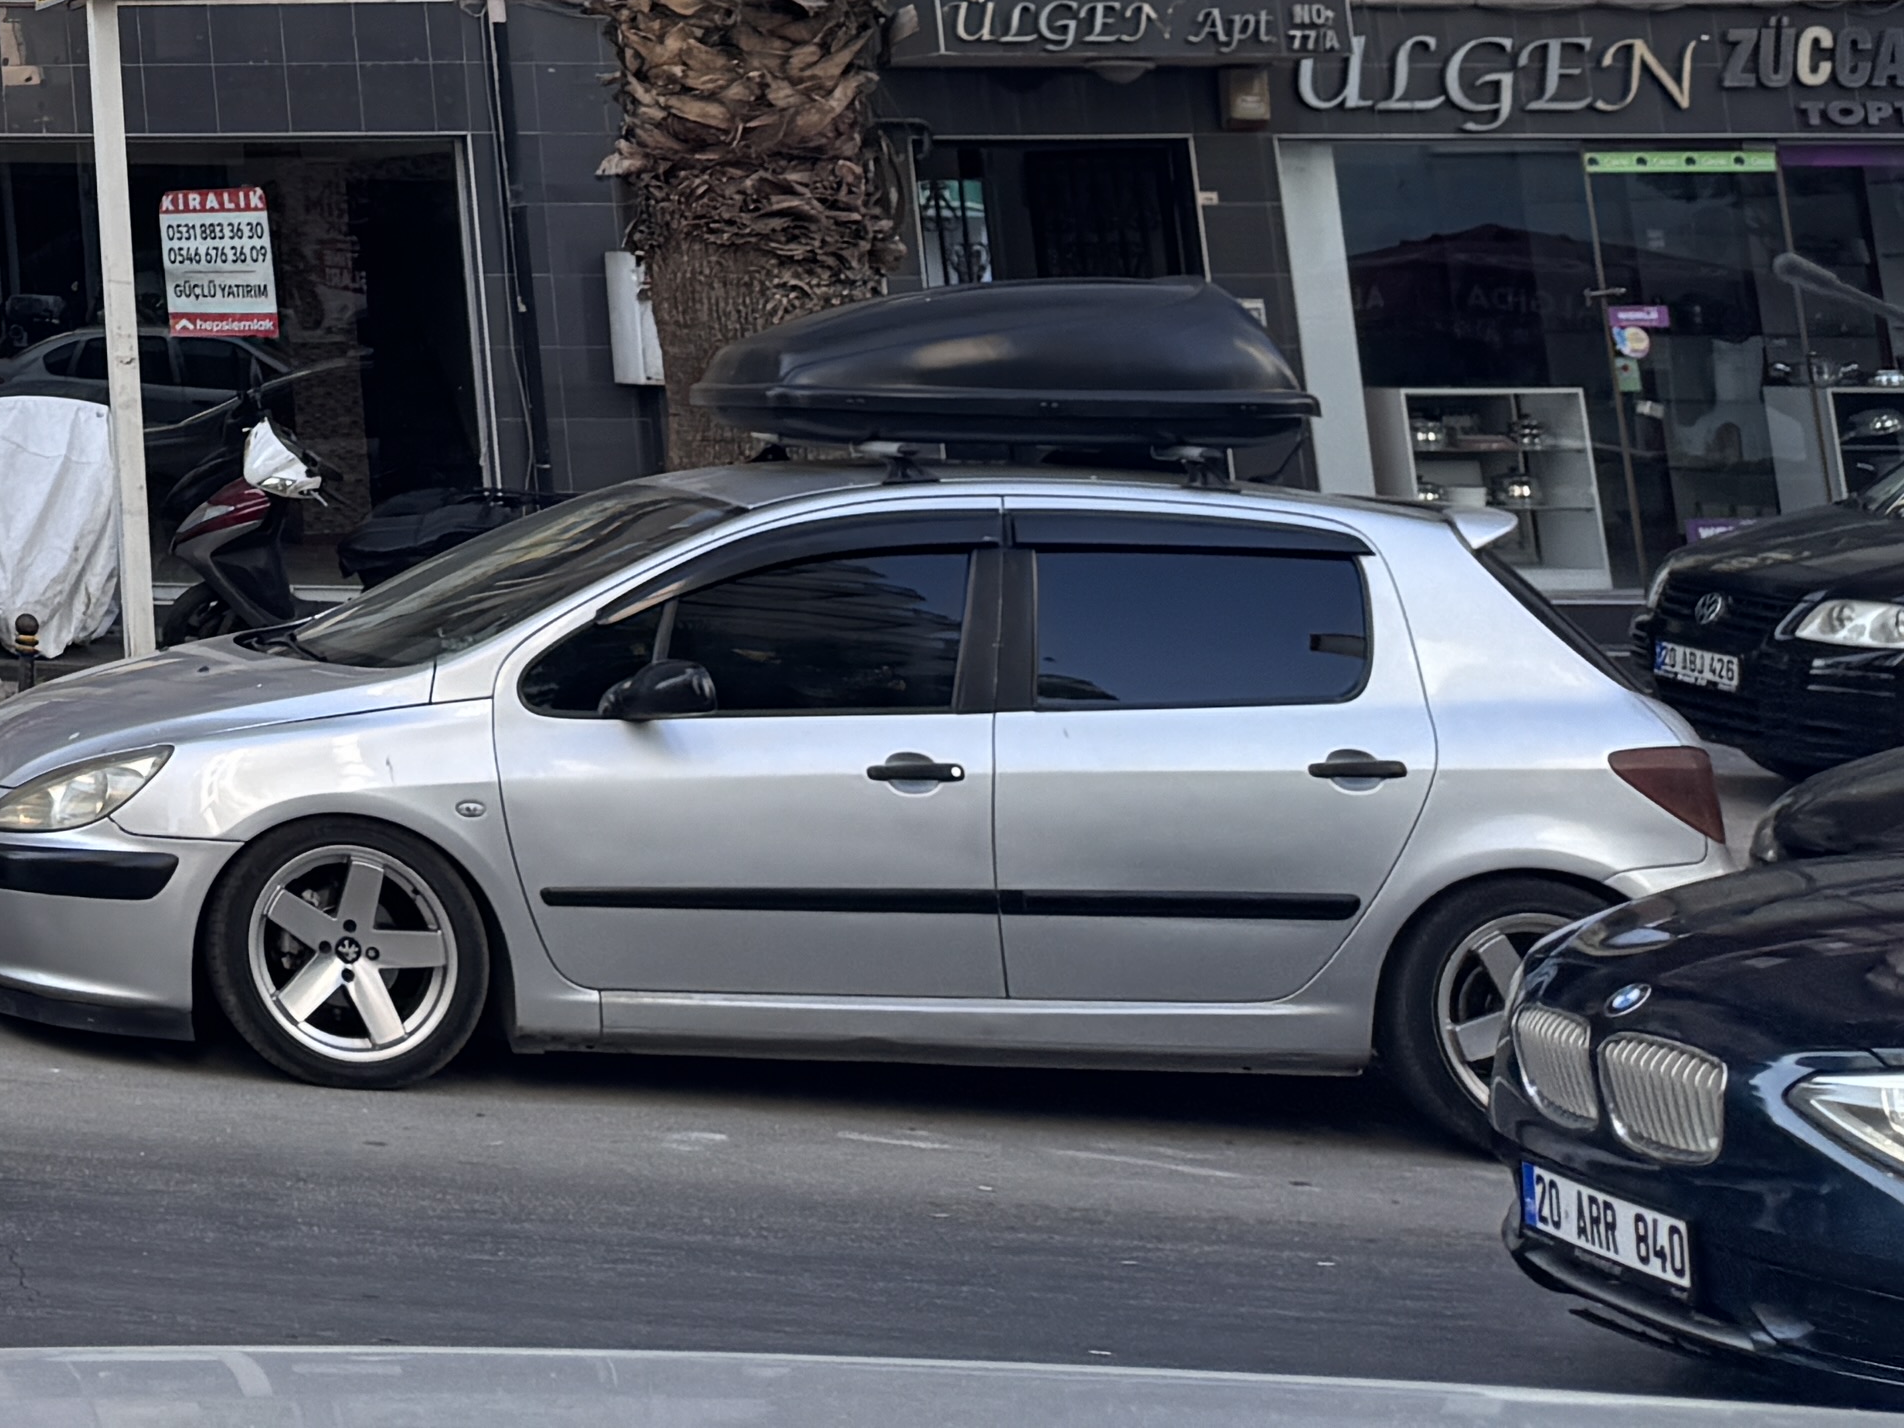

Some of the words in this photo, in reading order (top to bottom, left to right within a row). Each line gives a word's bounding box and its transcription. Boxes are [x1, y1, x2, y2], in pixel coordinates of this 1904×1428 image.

[166, 223, 198, 242] 0531
[200, 222, 226, 241] 883
[228, 222, 244, 240] 36
[246, 222, 264, 240] 30
[168, 246, 202, 265] 0546
[205, 246, 228, 265] 676
[231, 246, 247, 264] 36
[250, 245, 267, 263] 09
[174, 279, 217, 301] GÜÇLÜ
[218, 283, 268, 299] YATIRIM
[1709, 655, 1735, 682] 426
[1535, 1173, 1562, 1231] 20
[1576, 1190, 1620, 1256] ARR
[1634, 1212, 1686, 1279] 840
